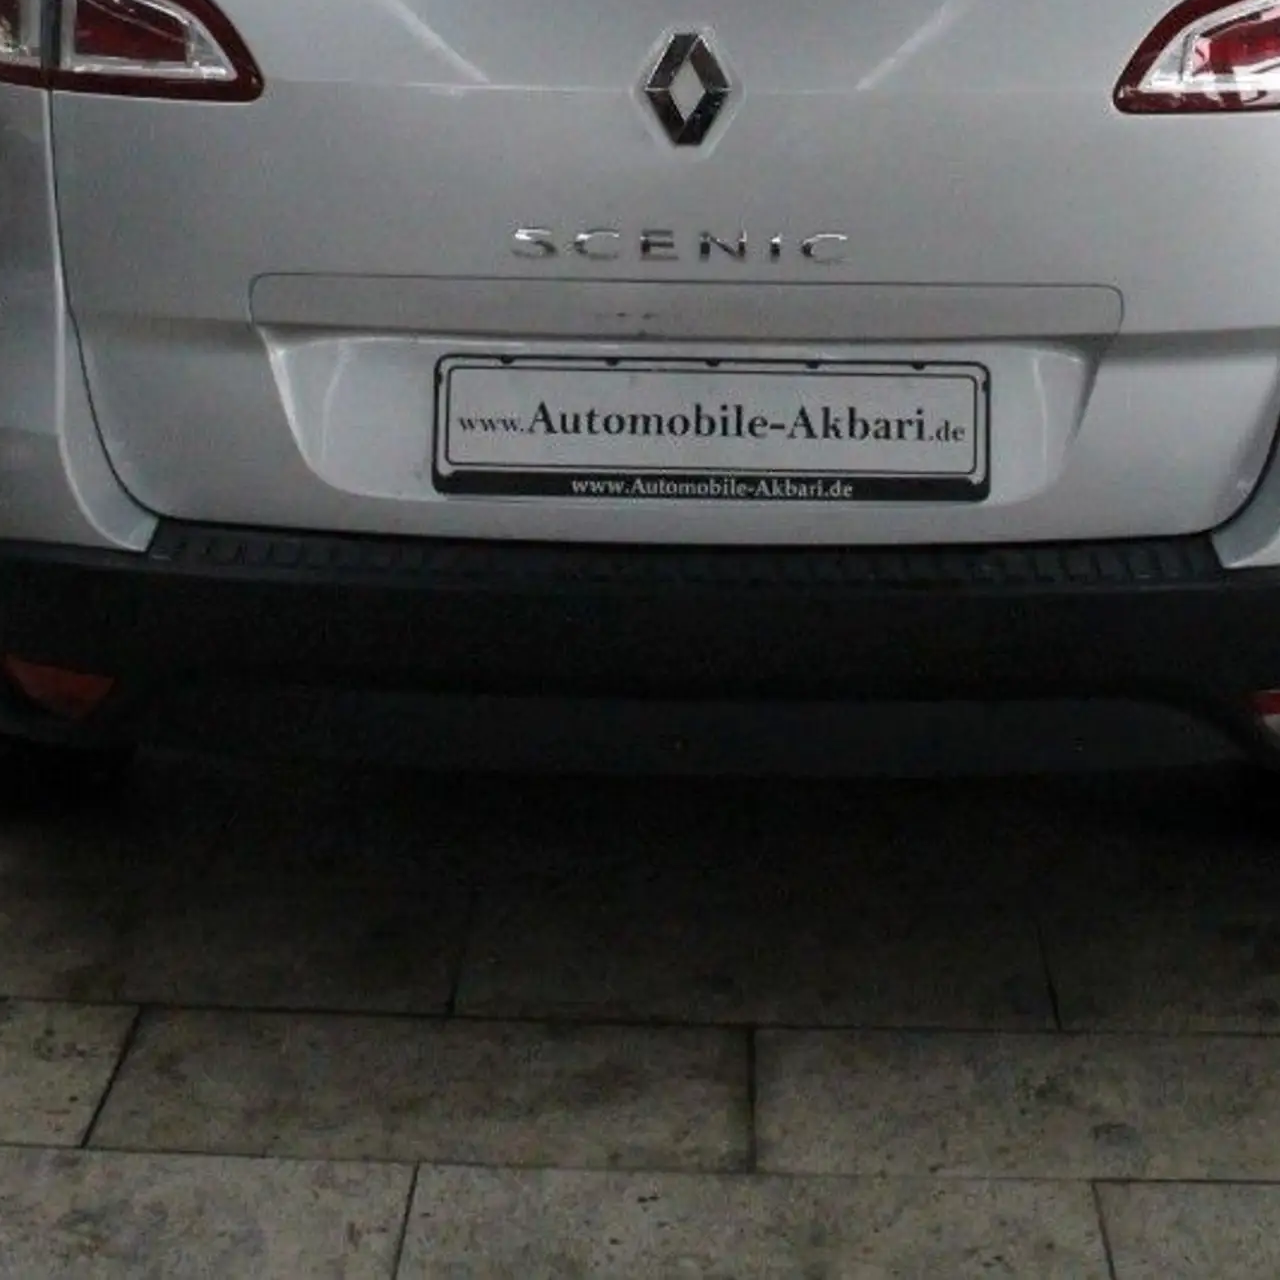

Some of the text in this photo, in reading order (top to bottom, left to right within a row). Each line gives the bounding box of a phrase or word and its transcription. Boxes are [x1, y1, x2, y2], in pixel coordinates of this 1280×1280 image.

[511, 226, 848, 265] SCENIC
[459, 401, 965, 444] www.Automobile-Akbari.de
[571, 477, 853, 499] www.Automobile-Akbari.de
